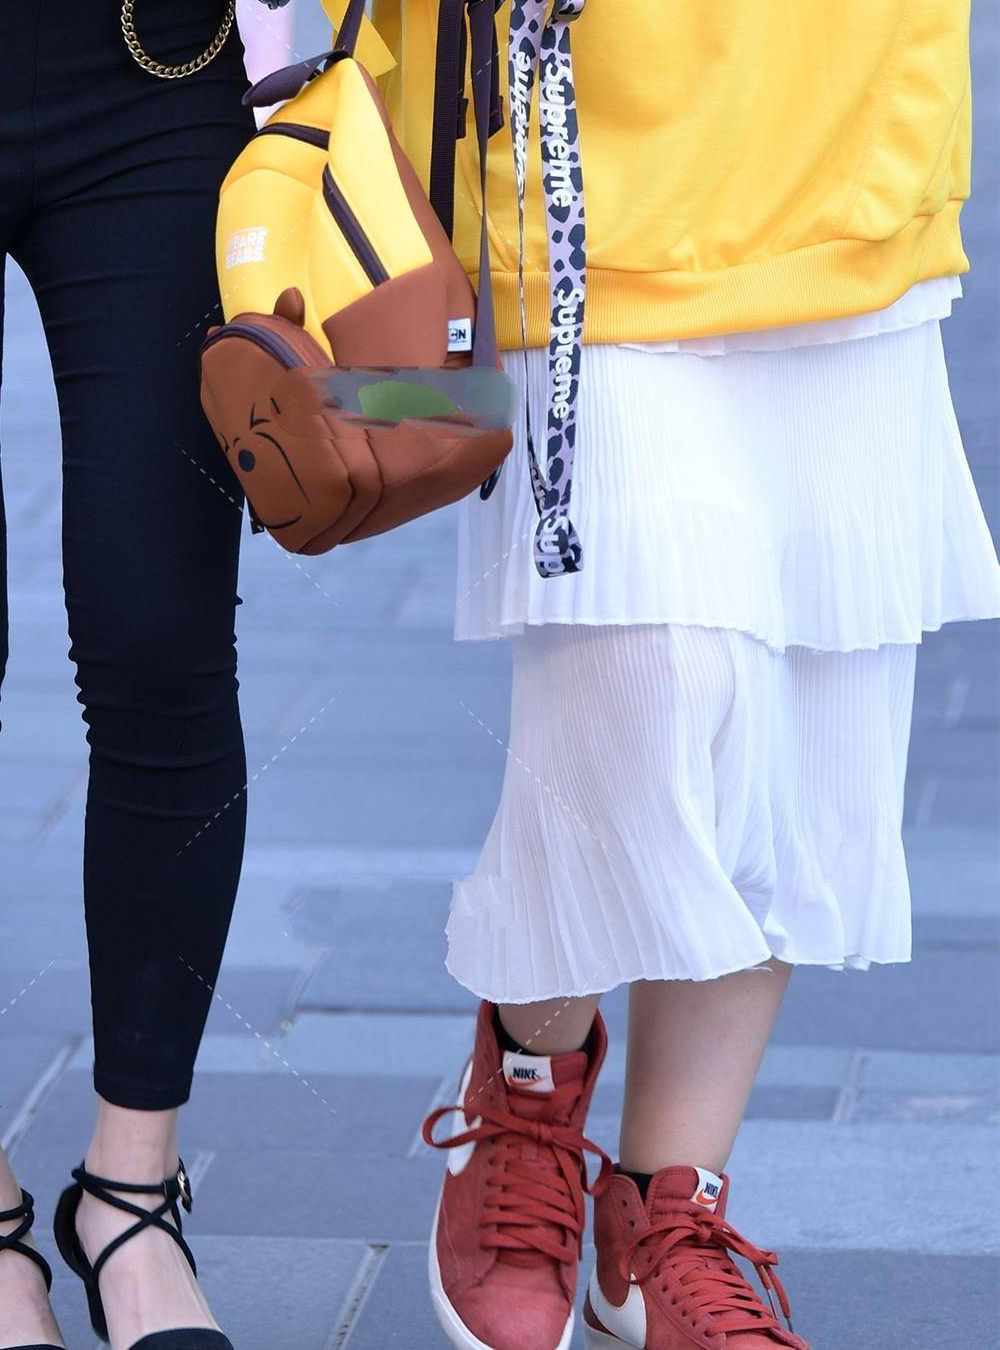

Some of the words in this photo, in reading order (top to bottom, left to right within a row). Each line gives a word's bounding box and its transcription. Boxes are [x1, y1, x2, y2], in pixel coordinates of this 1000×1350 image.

[540, 62, 573, 207] Supreme
[551, 288, 584, 419] Supreme
[513, 1067, 538, 1080] NIKE
